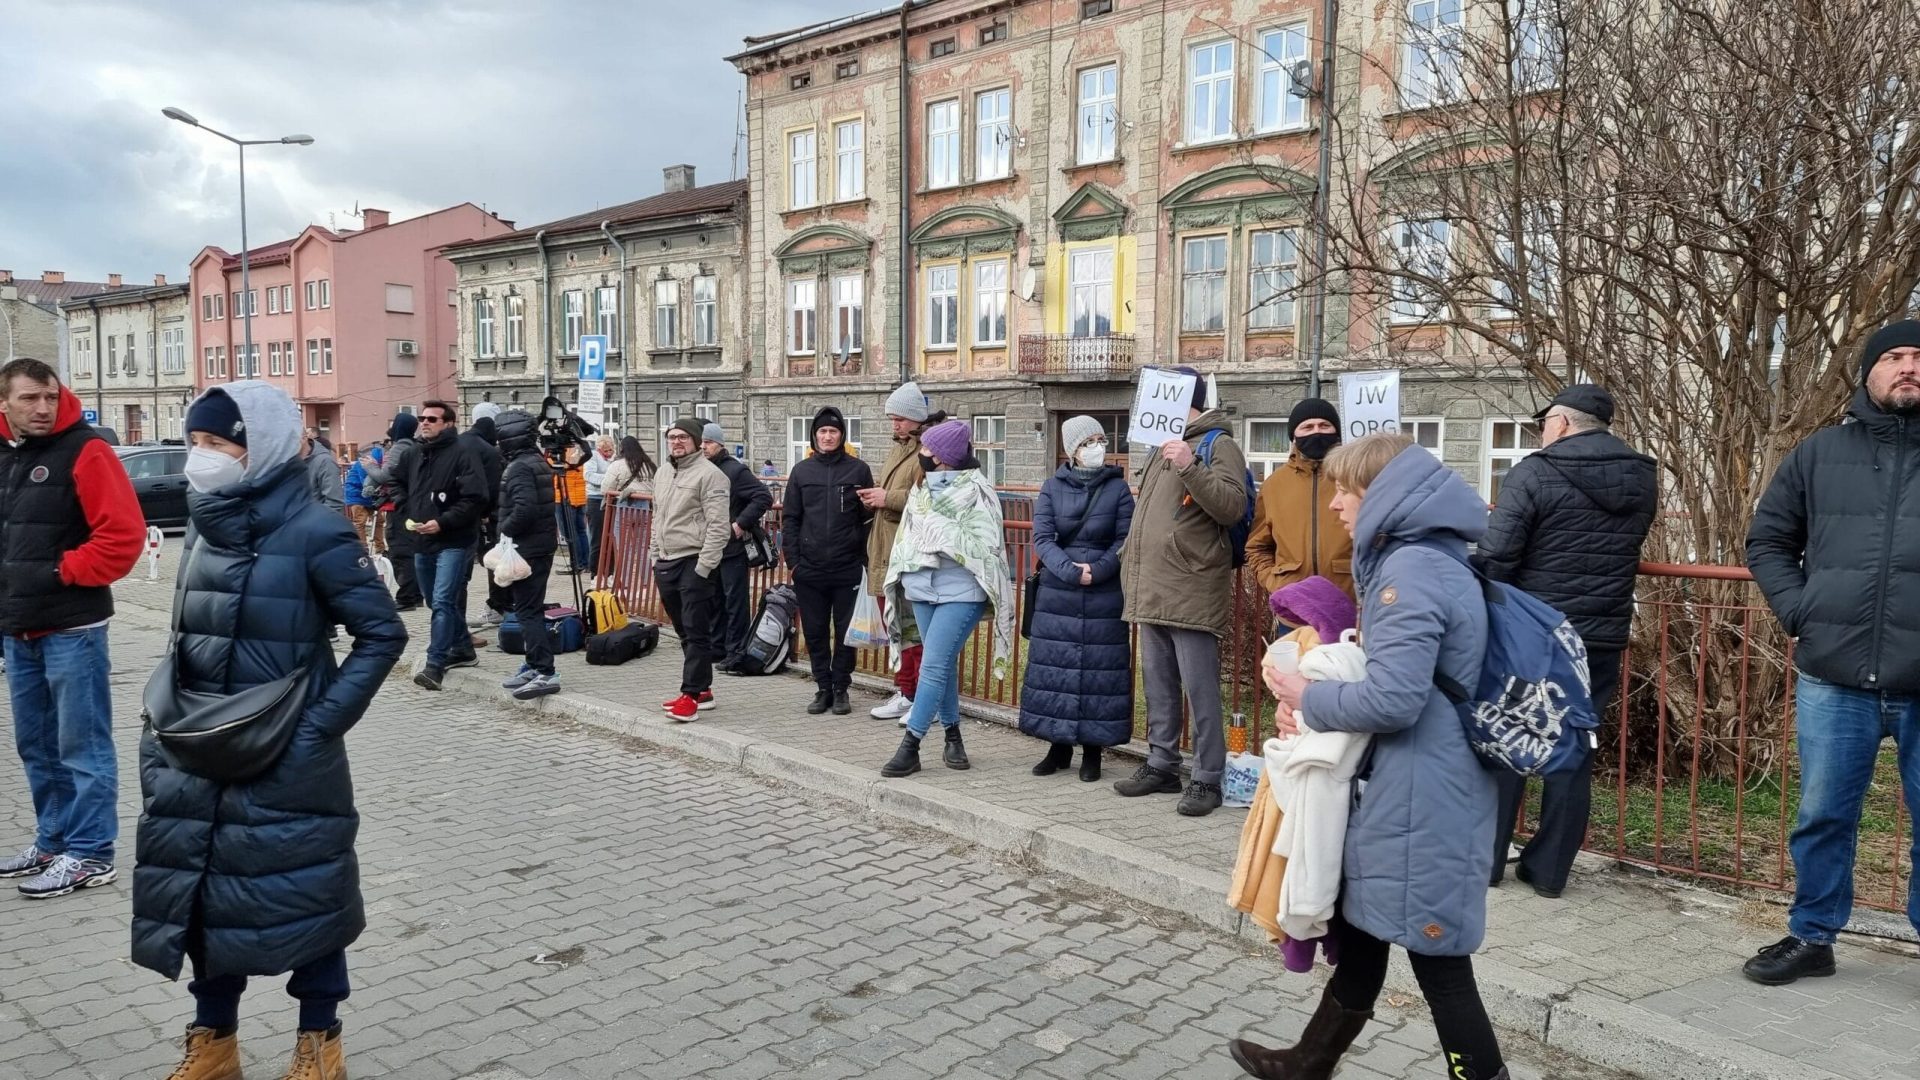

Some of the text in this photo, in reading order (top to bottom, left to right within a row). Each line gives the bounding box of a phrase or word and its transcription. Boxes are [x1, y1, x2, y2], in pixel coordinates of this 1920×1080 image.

[584, 340, 600, 375] P
[1151, 382, 1184, 402] JW
[1355, 385, 1388, 405] JW
[84, 411, 94, 421] P
[1140, 411, 1185, 435] ORG
